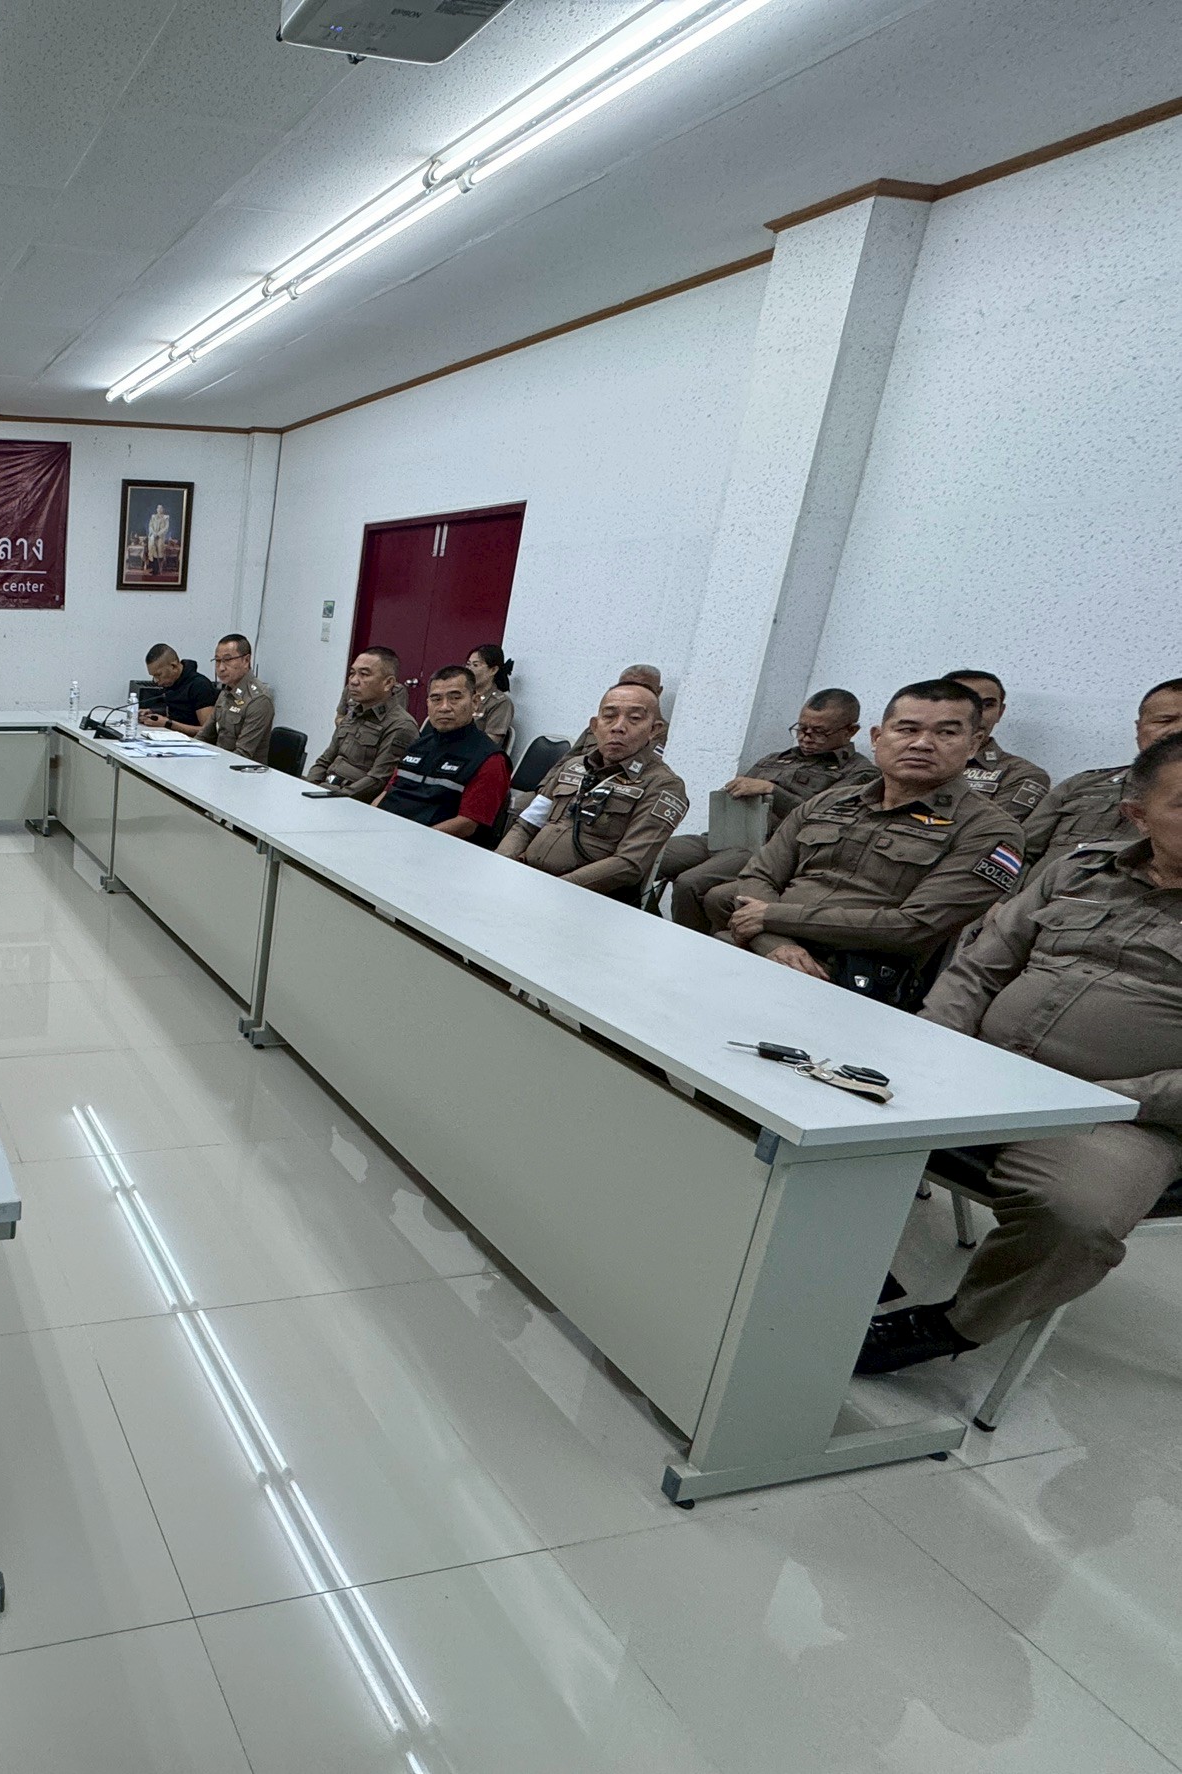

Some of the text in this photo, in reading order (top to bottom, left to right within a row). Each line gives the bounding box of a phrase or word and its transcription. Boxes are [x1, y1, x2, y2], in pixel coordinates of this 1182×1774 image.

[2, 581, 44, 593] center
[963, 769, 1000, 780] POLICE
[977, 861, 1015, 888] POLICE
